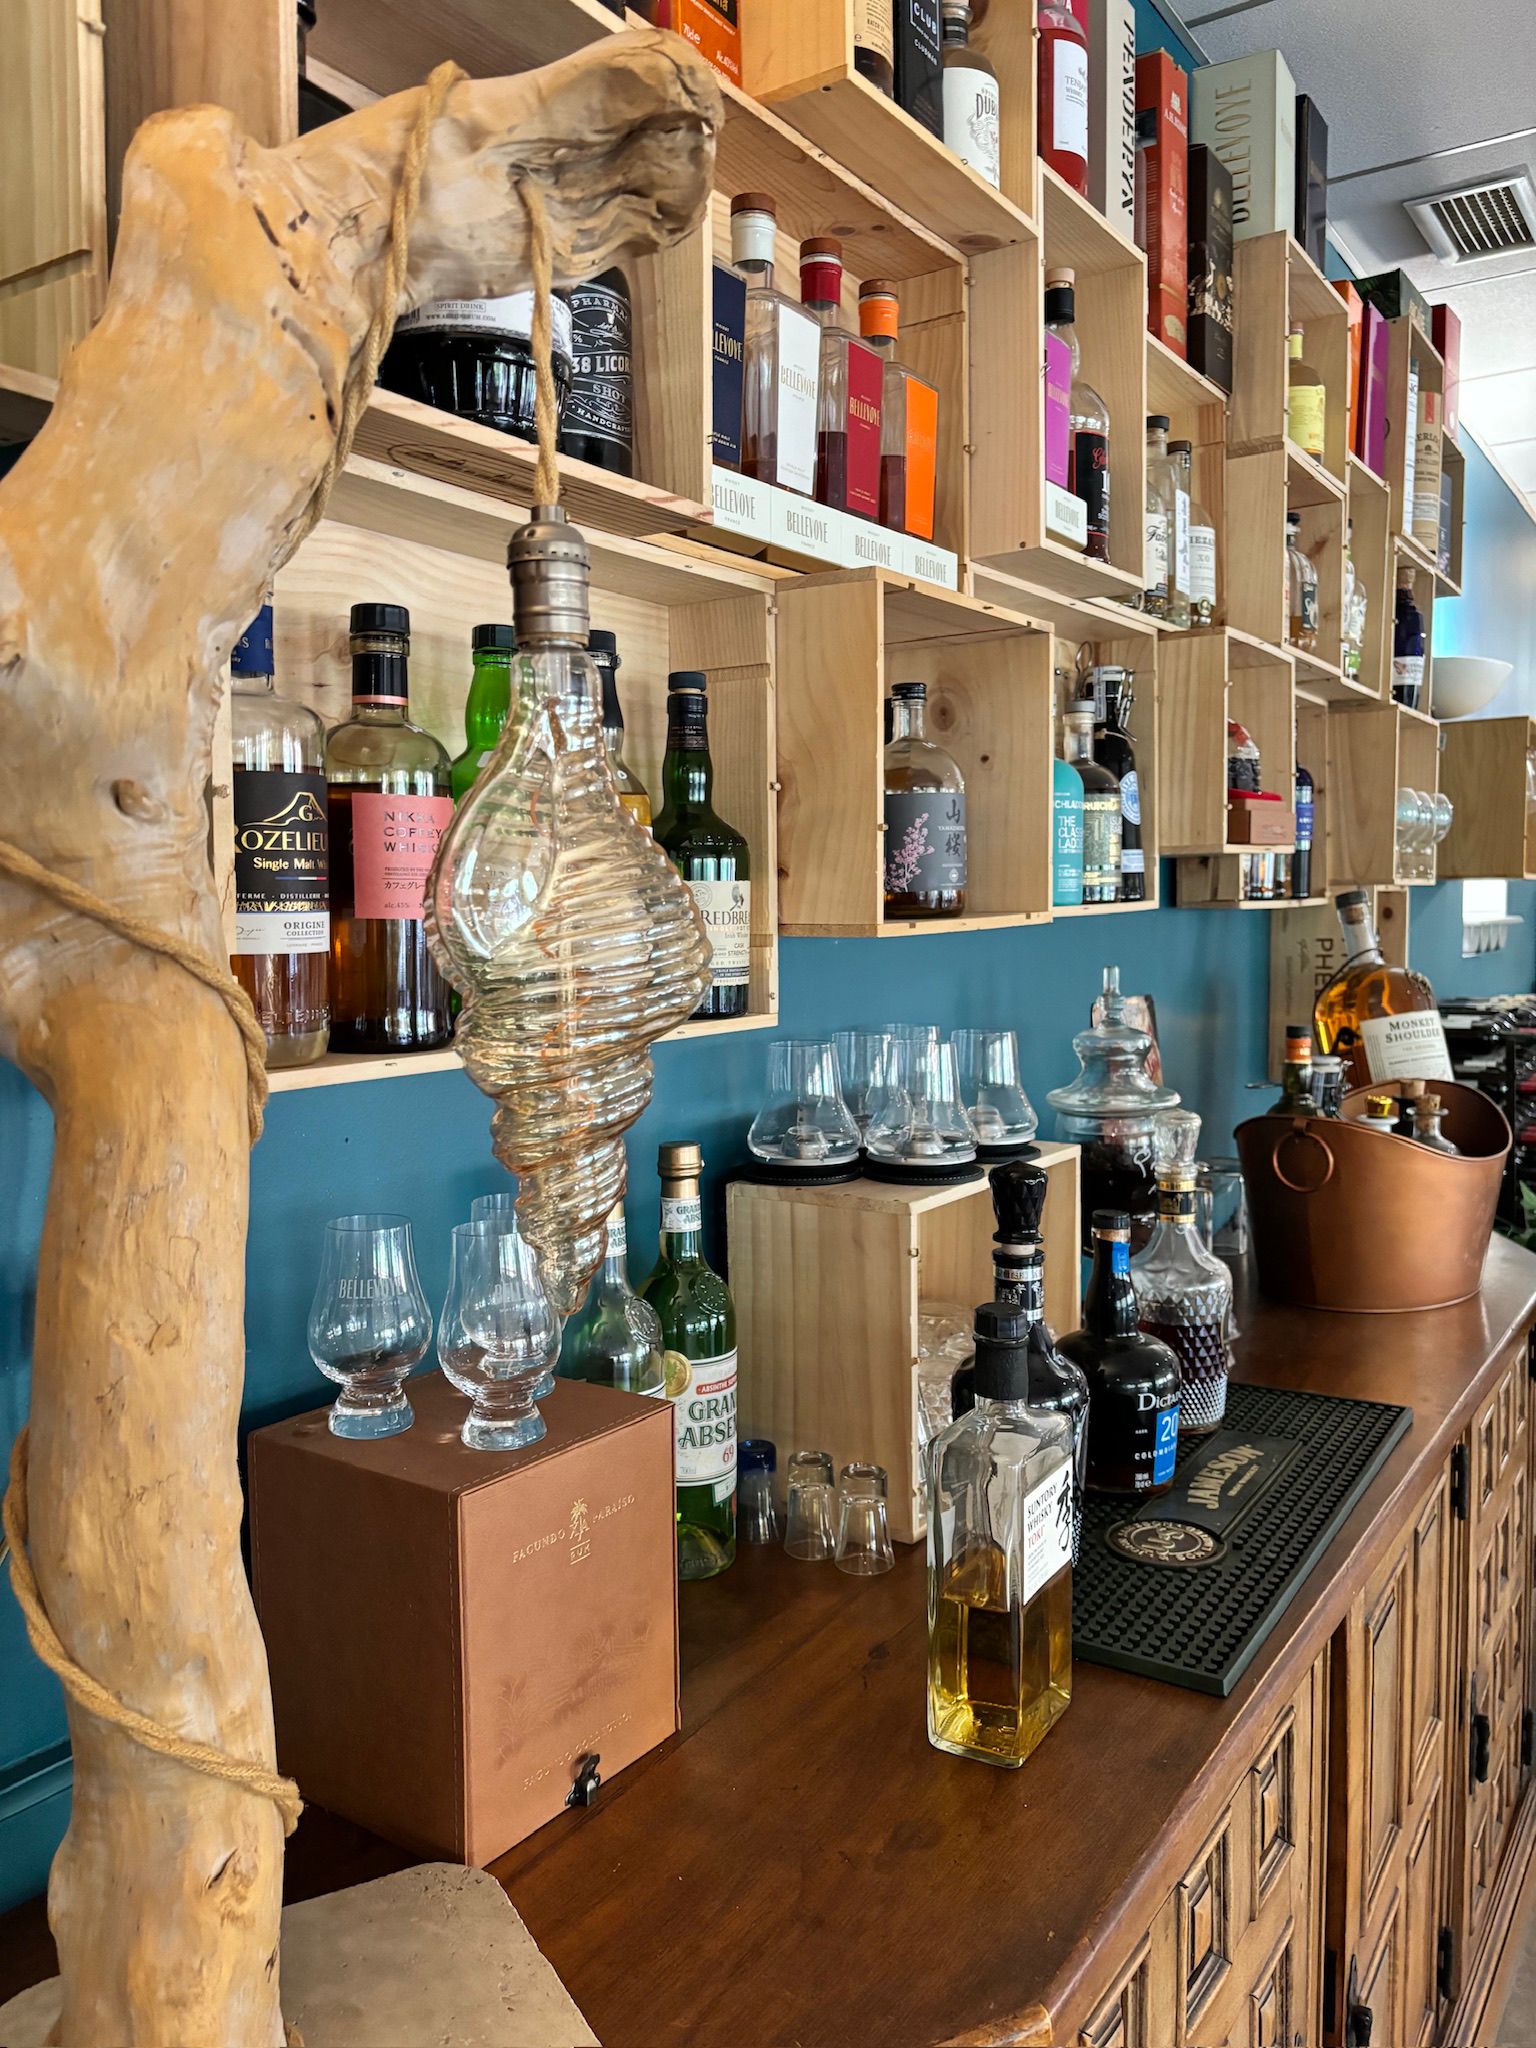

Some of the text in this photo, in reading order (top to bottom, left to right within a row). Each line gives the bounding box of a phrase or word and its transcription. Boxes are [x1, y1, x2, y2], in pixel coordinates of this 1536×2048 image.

[914, 2, 937, 35] CLUB
[914, 39, 937, 66] CLUBMAN
[1122, 20, 1135, 215] PENDERYN
[460, 302, 484, 311] DRINK
[571, 356, 591, 374] 38
[781, 366, 816, 400] BELLEVOYE
[850, 397, 880, 427] BELLEVOYE
[786, 510, 829, 544] BELLEVOYE
[855, 535, 892, 567] BELLEVOYE
[915, 555, 947, 583] BELLEVOYE
[384, 811, 434, 824] NIKKA
[1058, 816, 1076, 827] THE
[384, 826, 442, 839] COFFEY
[253, 857, 289, 871] Single
[294, 857, 315, 869] Malt
[284, 921, 325, 930] ORIGINE
[1315, 938, 1333, 998] PHE
[1389, 1017, 1435, 1033] MONKEY
[338, 1279, 403, 1299] BELLEVOYE
[701, 1381, 728, 1394] ABSINTHE
[1161, 1412, 1178, 1442] 20
[723, 1444, 735, 1463] 69
[1187, 1443, 1264, 1510] JAMESON
[1027, 1484, 1057, 1518] SUNTORY
[1027, 1500, 1053, 1533] WHISKY
[512, 1528, 566, 1563] FACUNDO
[1027, 1526, 1045, 1549] TOKI
